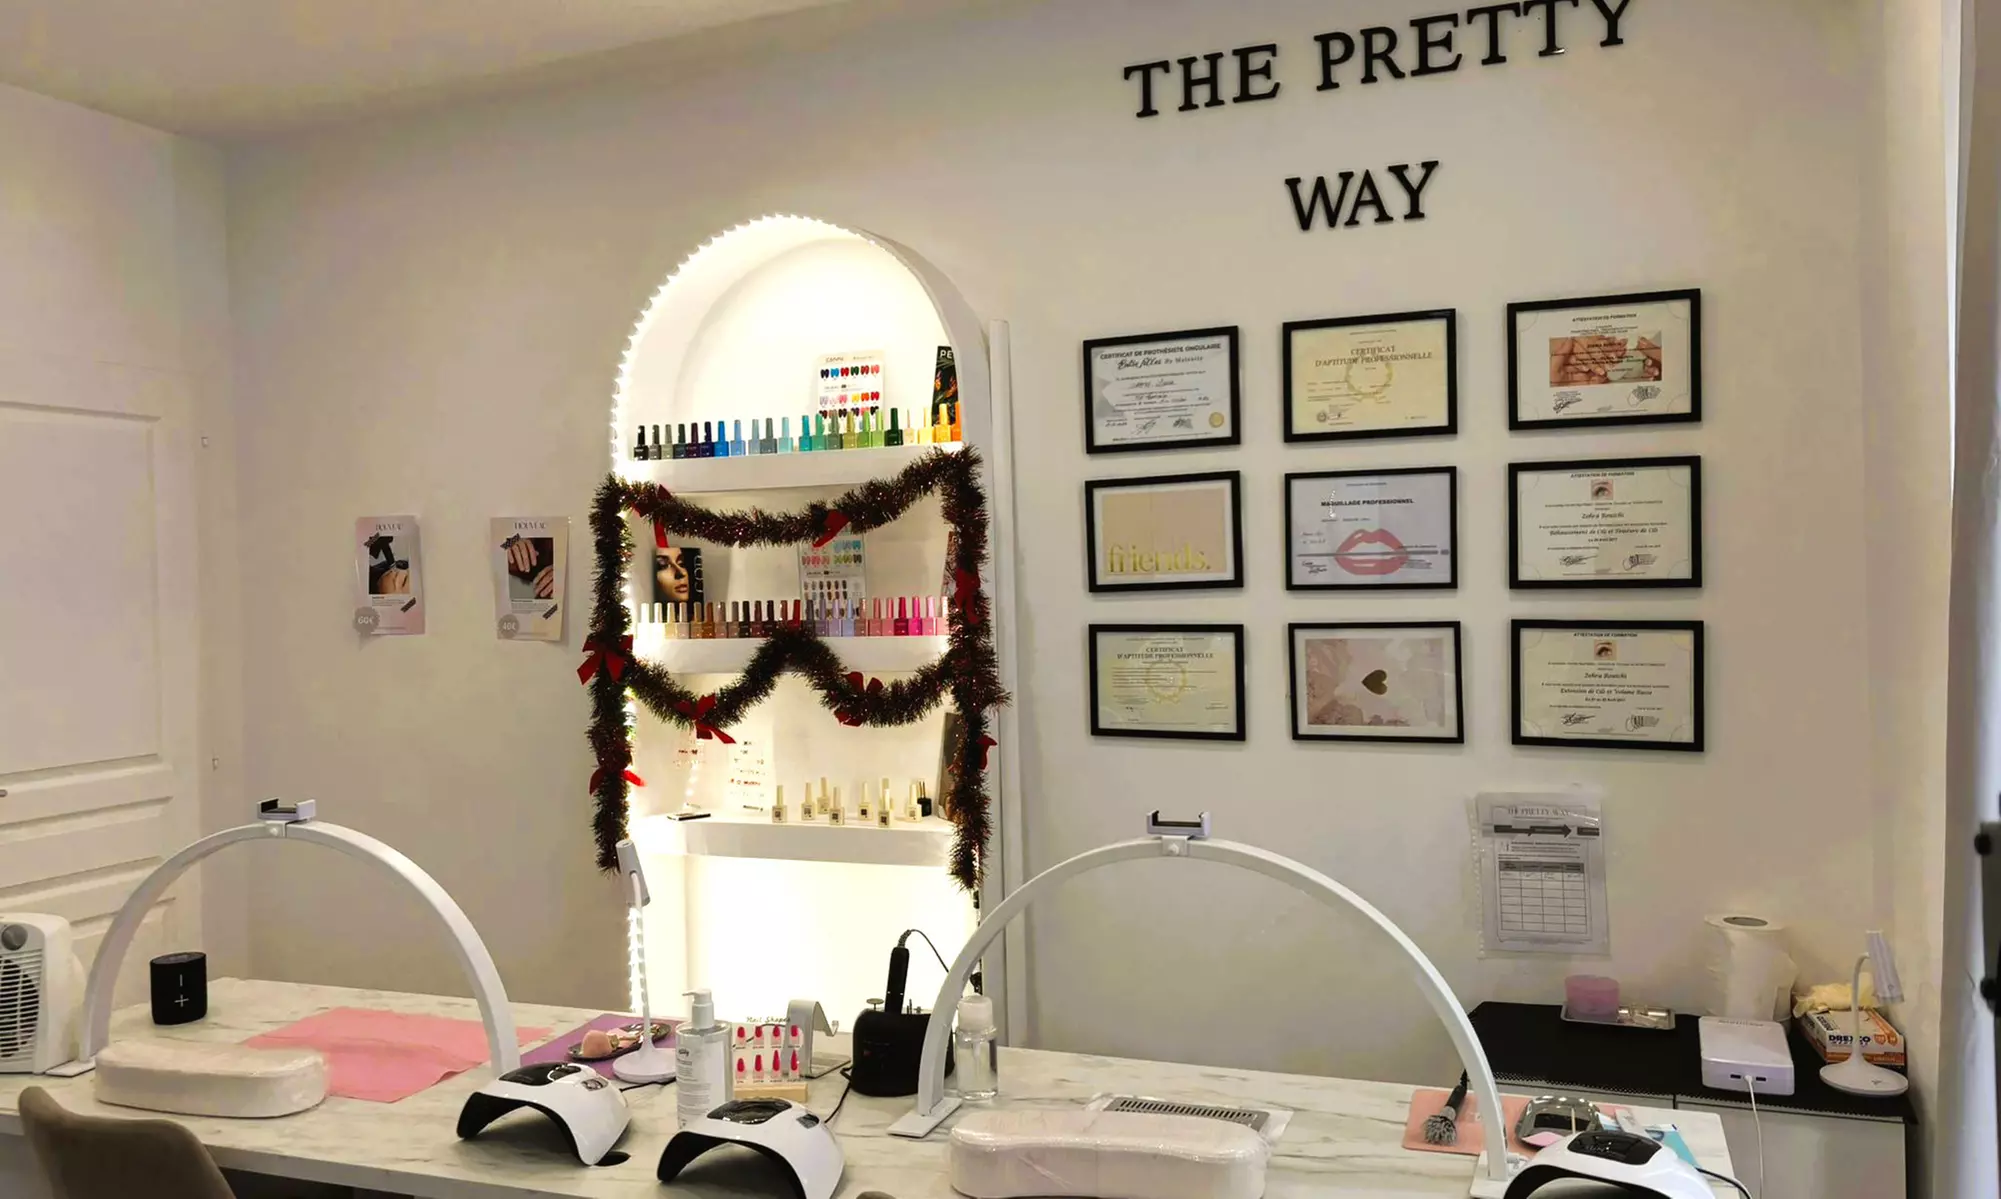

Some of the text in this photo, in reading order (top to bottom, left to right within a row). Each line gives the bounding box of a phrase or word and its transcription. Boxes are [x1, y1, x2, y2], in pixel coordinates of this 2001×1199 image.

[1124, 0, 1633, 118] THE PRETTY
[1285, 161, 1440, 232] WAY
[1100, 351, 1133, 360] CERTIFICAT
[1350, 345, 1395, 356] CERTIFICAT
[1108, 541, 1212, 573] friends.
